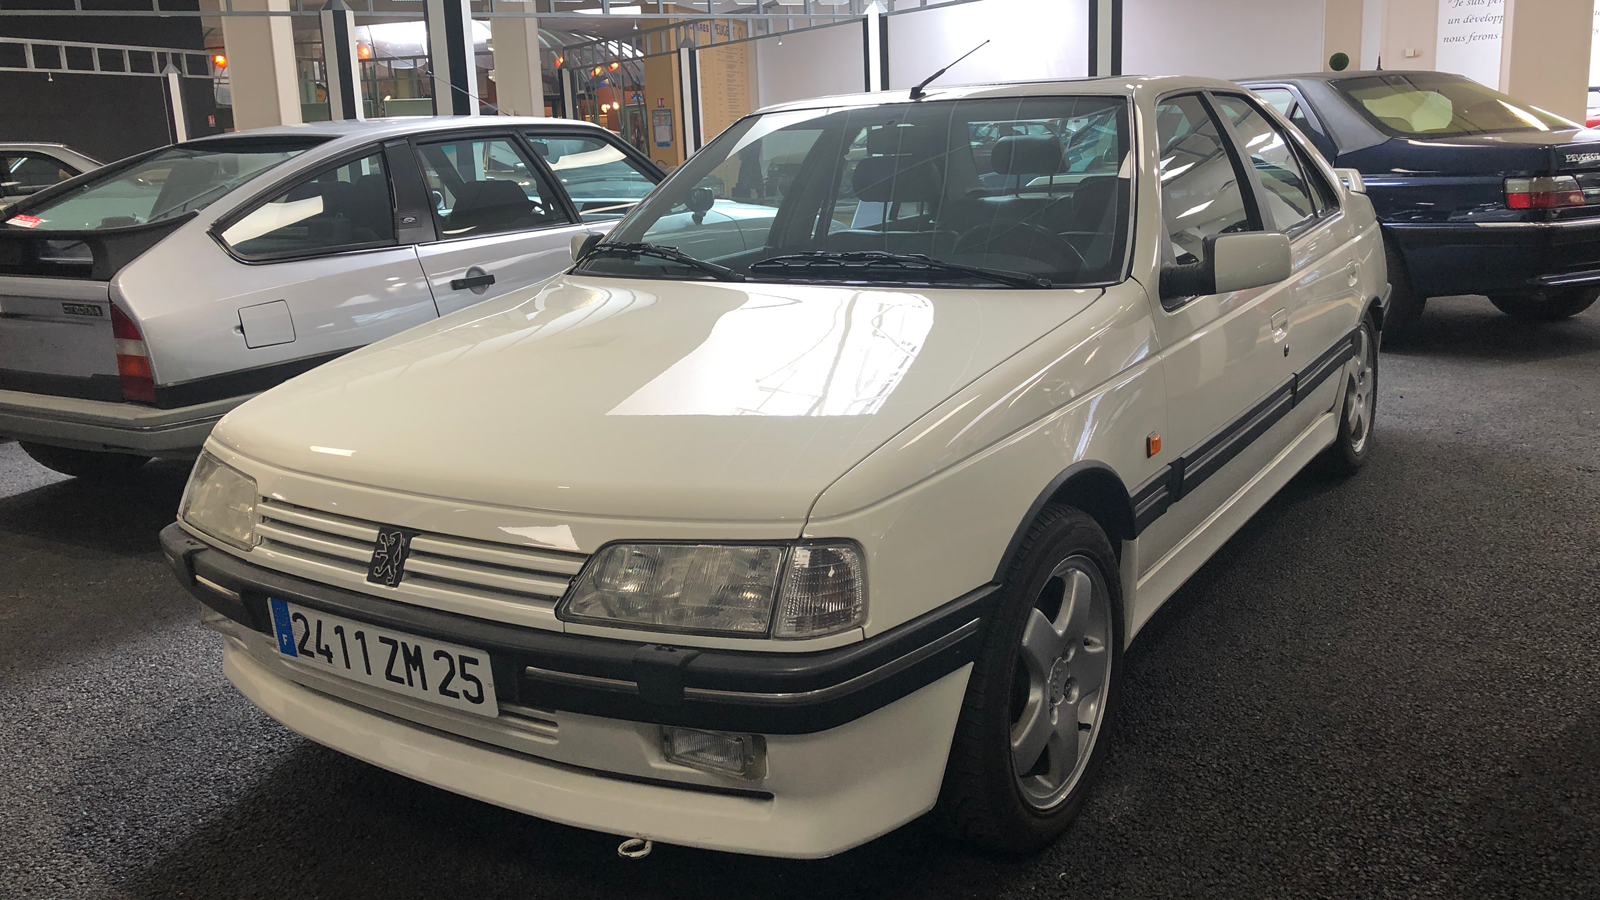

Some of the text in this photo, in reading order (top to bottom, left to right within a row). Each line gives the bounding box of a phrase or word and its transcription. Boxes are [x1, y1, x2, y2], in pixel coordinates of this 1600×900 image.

[1465, 31, 1499, 44] ferons
[1565, 152, 1599, 163] PEUGEOT
[281, 634, 288, 646] F
[291, 612, 485, 705] 2411 ZM 25
